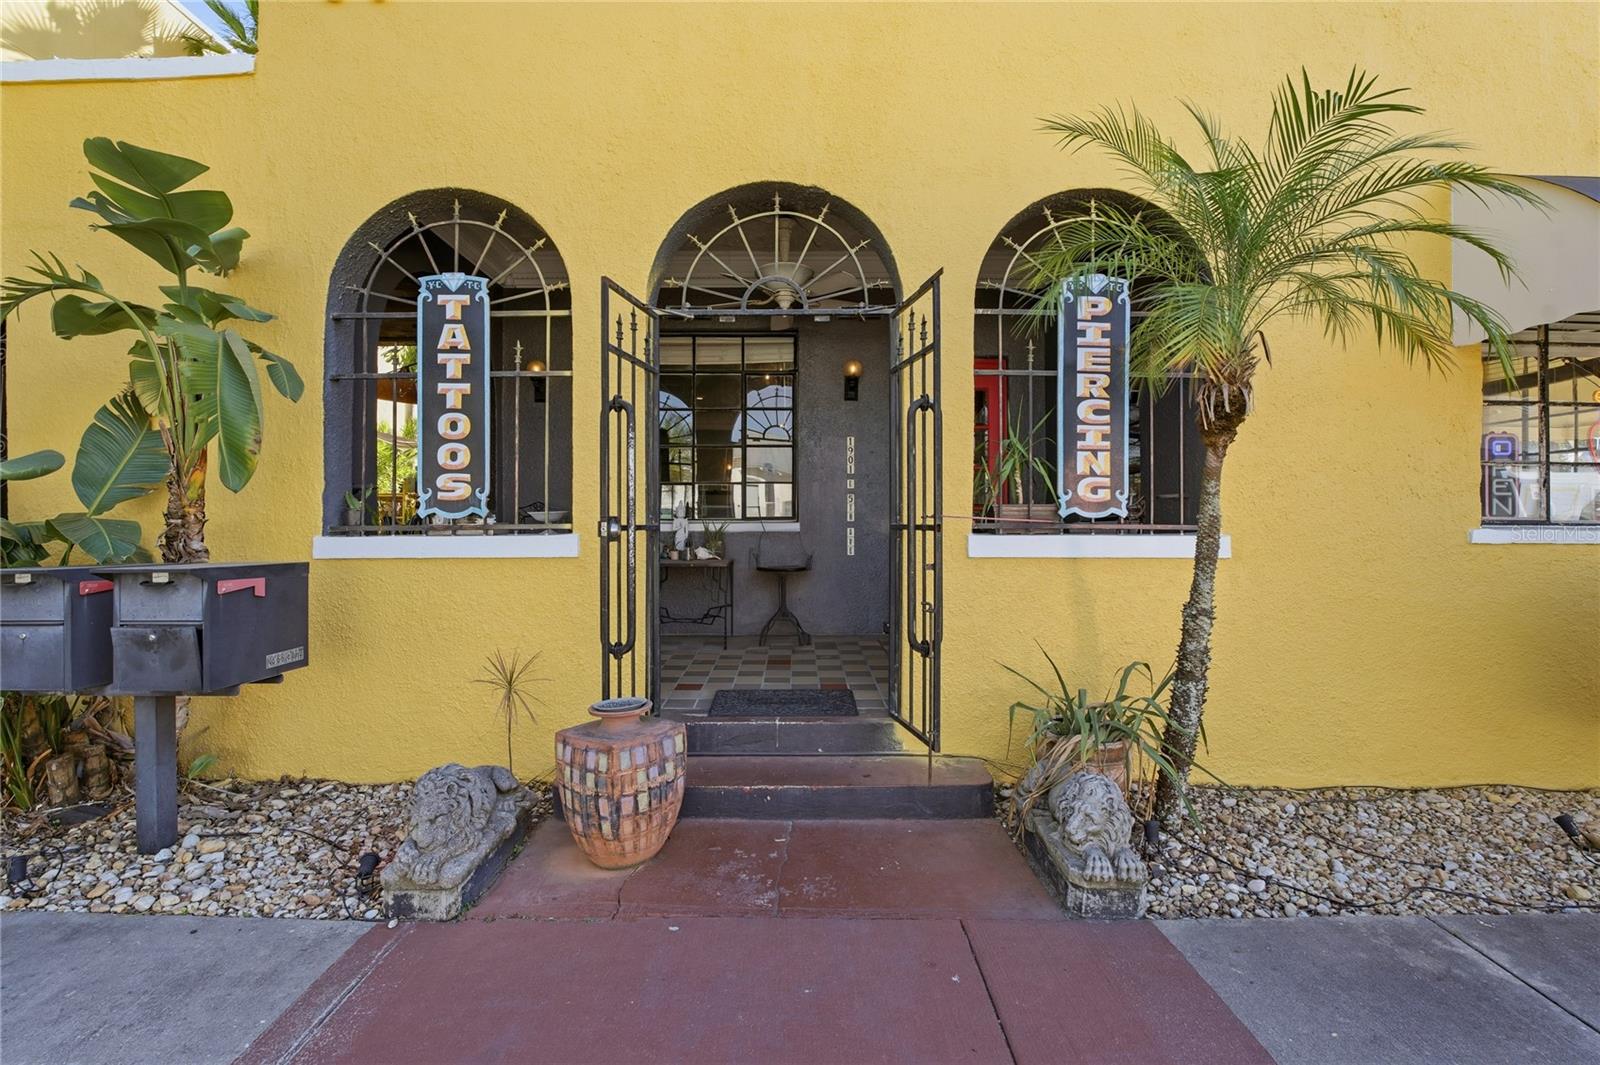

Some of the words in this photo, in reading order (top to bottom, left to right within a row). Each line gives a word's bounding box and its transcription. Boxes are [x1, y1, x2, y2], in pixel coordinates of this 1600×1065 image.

[436, 294, 472, 500] TATTOOS
[847, 437, 855, 474] 1901
[1076, 295, 1113, 503] PIERCING
